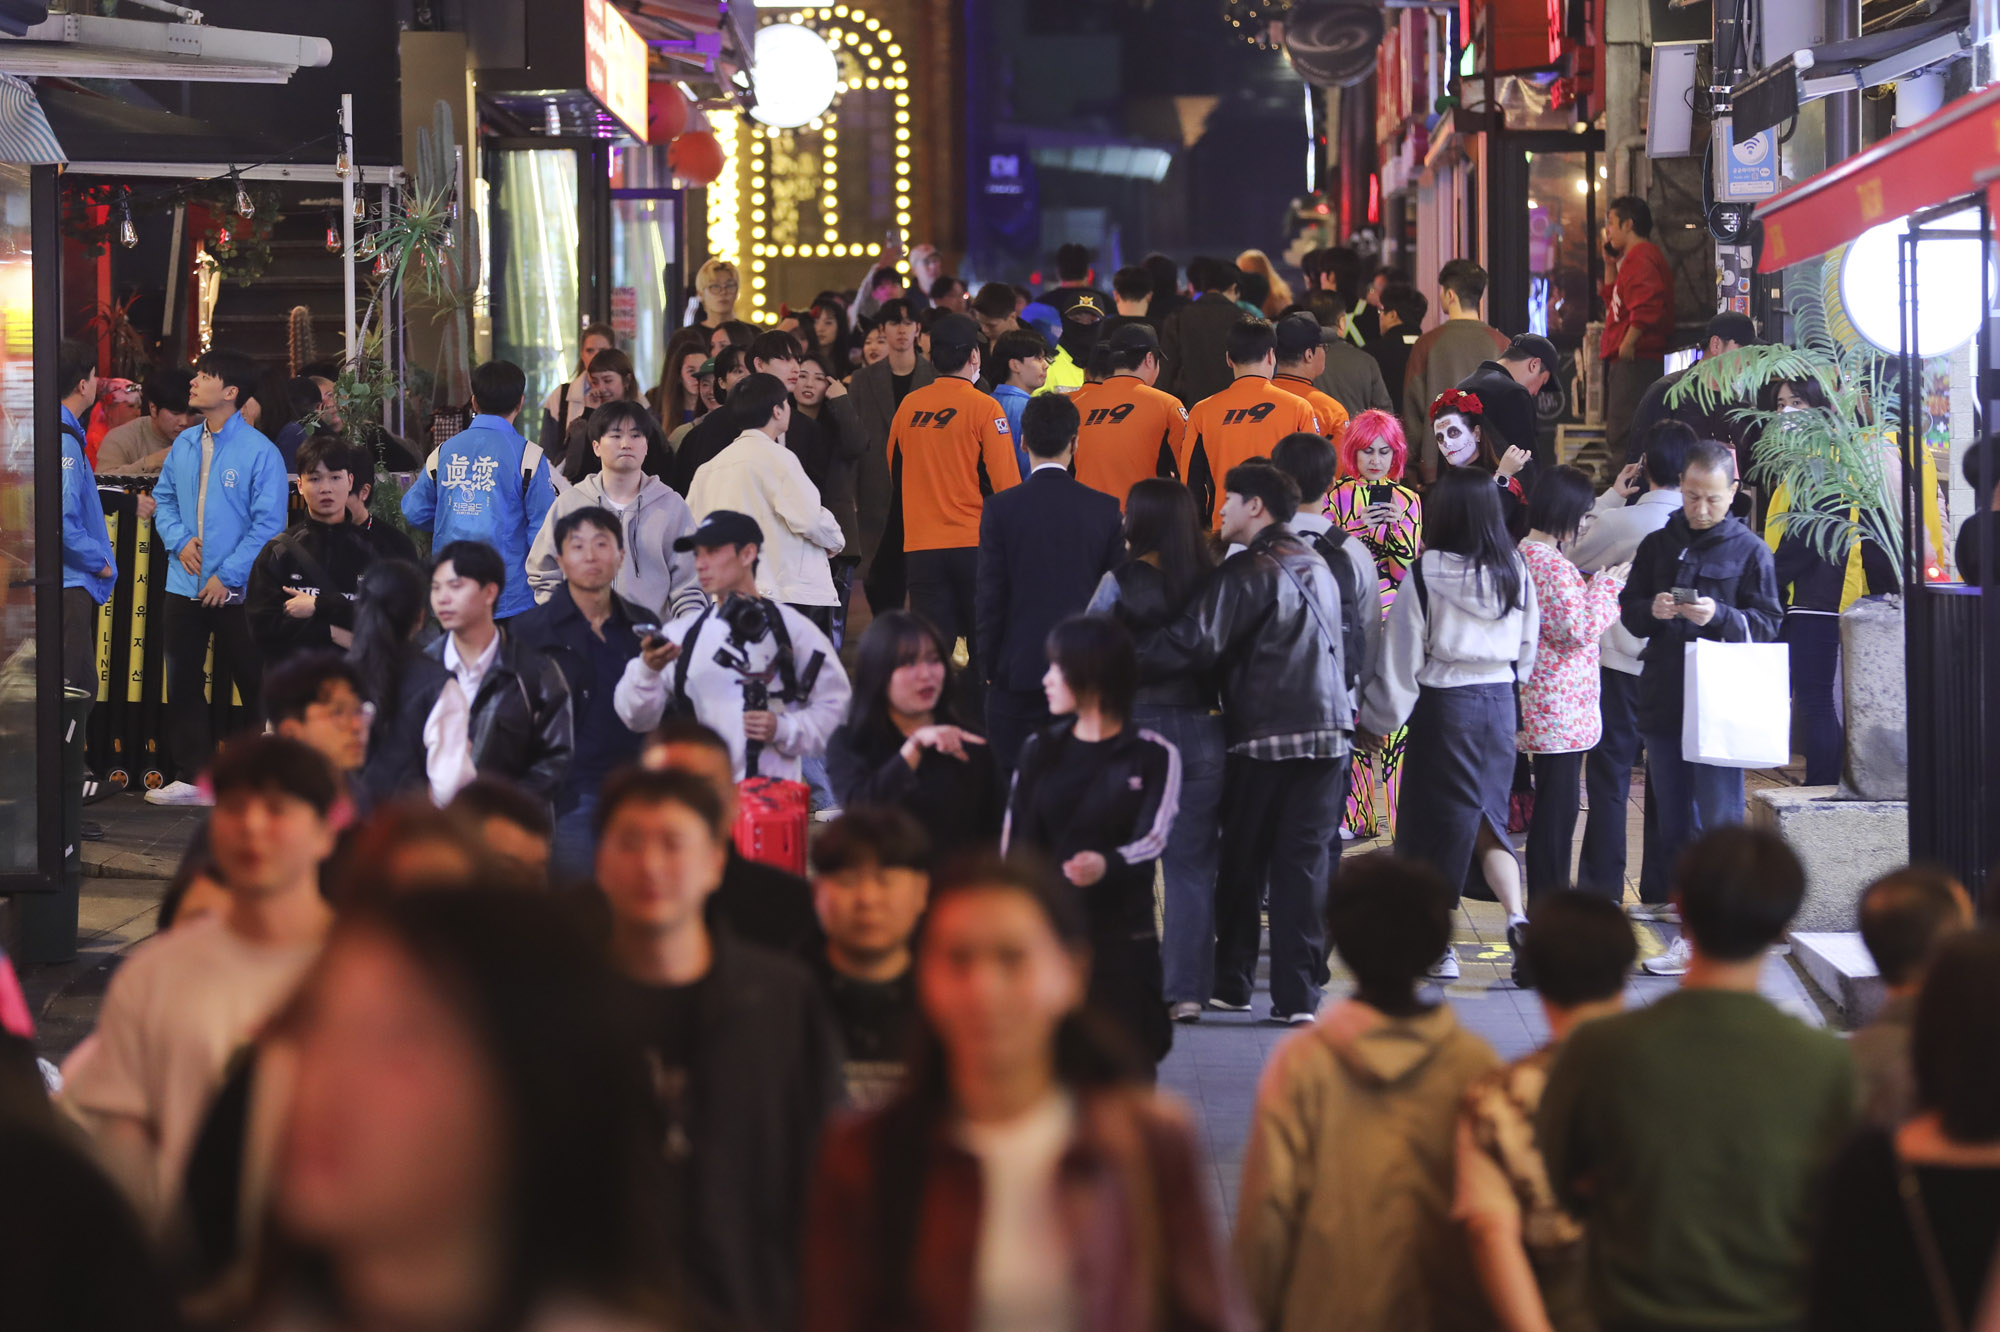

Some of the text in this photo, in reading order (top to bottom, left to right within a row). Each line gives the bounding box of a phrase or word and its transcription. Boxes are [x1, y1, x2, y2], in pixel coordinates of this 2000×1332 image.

[910, 408, 958, 428] 119
[1084, 403, 1135, 426] 119
[1222, 402, 1276, 425] 119
[452, 502, 483, 513] 진로골드
[100, 631, 109, 681] LINE
